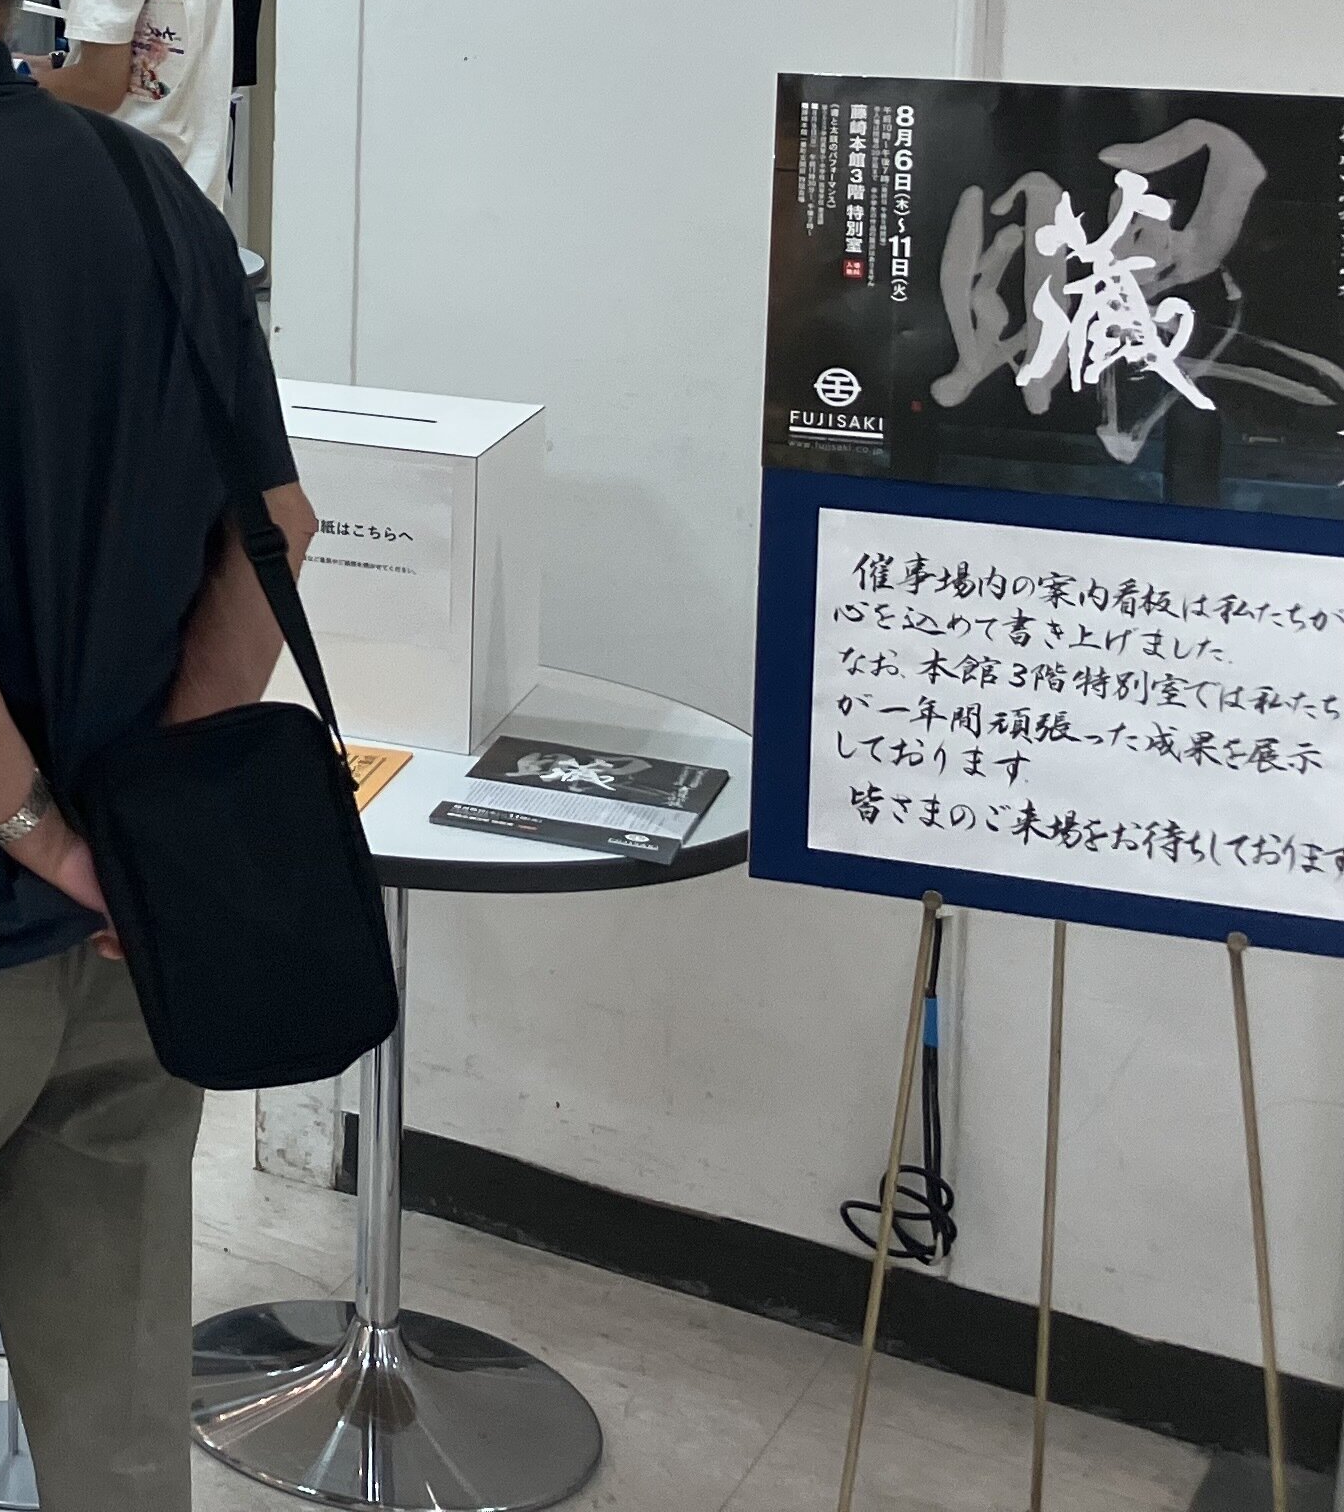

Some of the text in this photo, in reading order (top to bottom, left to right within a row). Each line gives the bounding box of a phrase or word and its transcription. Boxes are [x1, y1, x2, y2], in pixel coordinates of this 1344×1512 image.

[845, 104, 868, 253] 藤崎本館3階 特別室
[790, 409, 883, 431] FUJISAKI
[835, 692, 1324, 776] が一年間頑張った成果を展示
